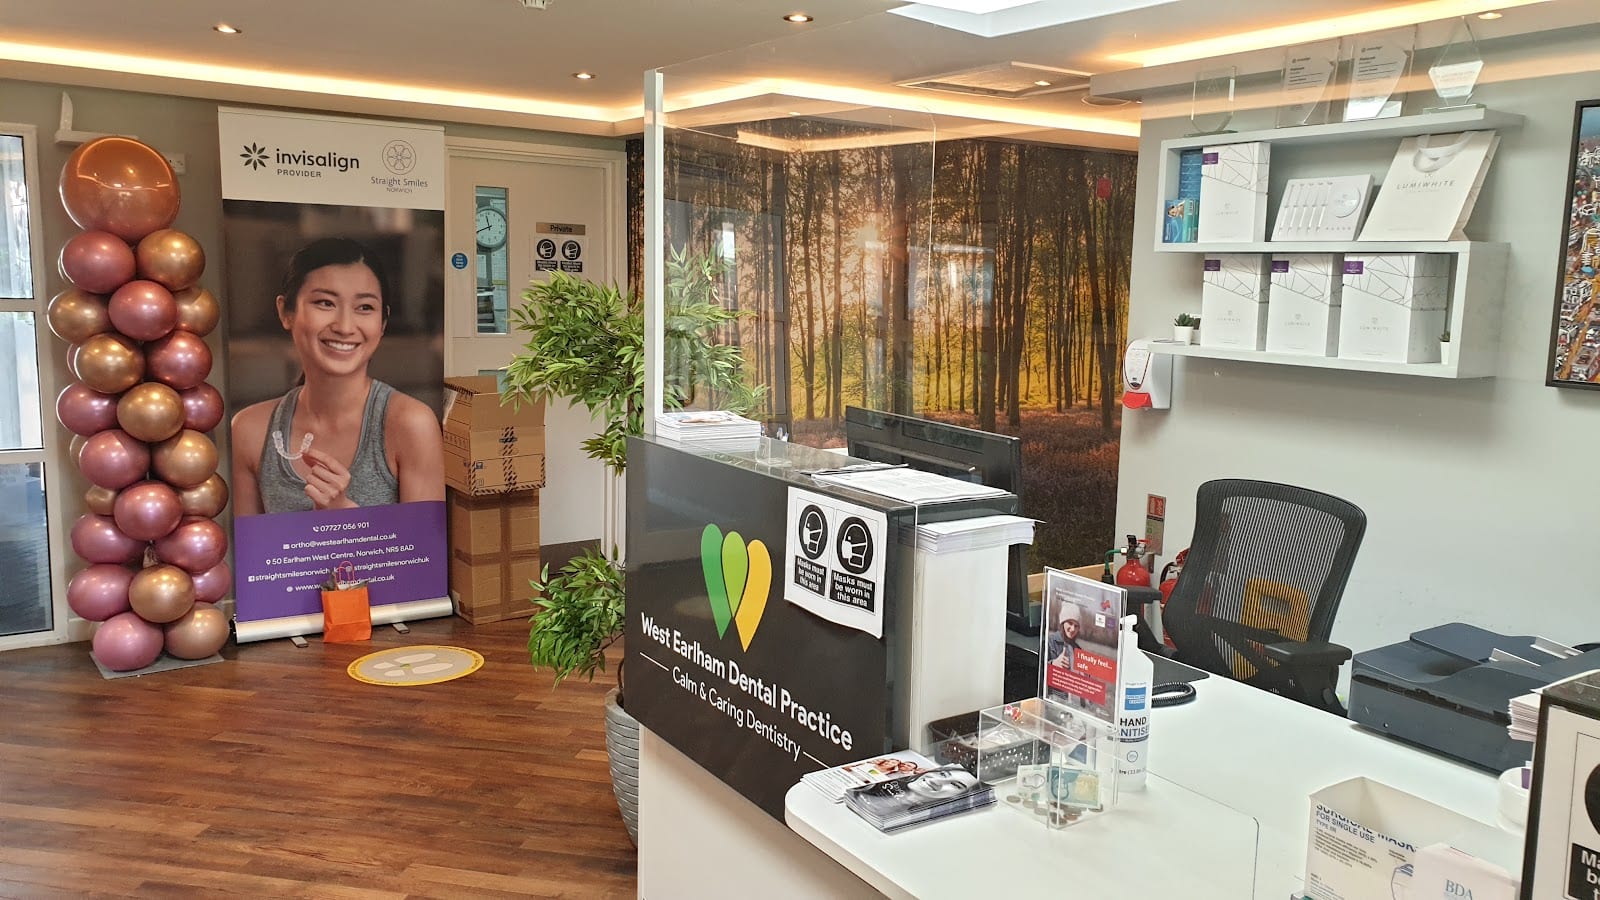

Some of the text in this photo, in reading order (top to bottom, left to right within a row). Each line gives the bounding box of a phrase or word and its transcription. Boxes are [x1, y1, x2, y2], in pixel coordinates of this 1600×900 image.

[276, 148, 359, 172] invisalign
[277, 168, 322, 178] PROVIDER
[370, 176, 428, 188] Straight Smiles
[550, 224, 573, 233] Private
[320, 521, 370, 532] 07727 056 901
[283, 556, 312, 564] Earlham
[312, 553, 330, 561] West
[255, 566, 339, 582] straightsmilesnorwichk
[833, 572, 873, 592] Masks must
[834, 581, 870, 599] be worn in
[837, 591, 868, 607] this area
[1076, 662, 1089, 671] safe
[1080, 653, 1097, 666] finally
[641, 612, 853, 751] West Earlham Dental Practice
[672, 666, 801, 762] Calm & Caring Dentistry
[1119, 716, 1147, 727] HAND
[1316, 819, 1329, 830] TYPE
[1316, 810, 1330, 822] FOR
[1332, 817, 1358, 836] SINGLE
[1359, 830, 1376, 844] USE
[1445, 879, 1473, 900] BDA
